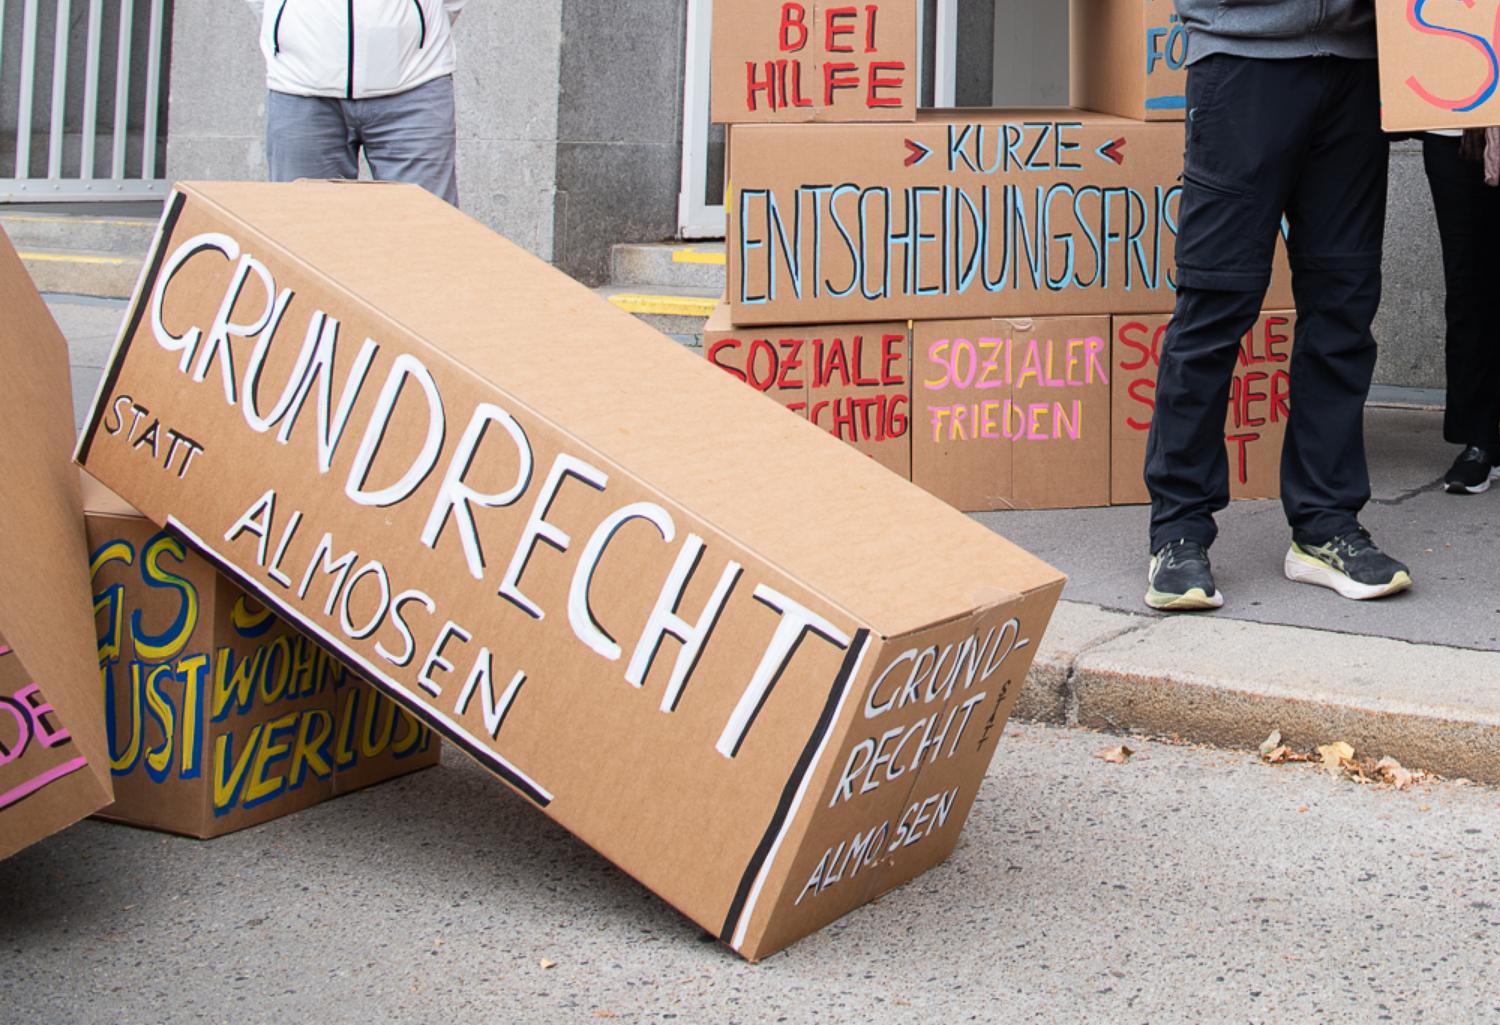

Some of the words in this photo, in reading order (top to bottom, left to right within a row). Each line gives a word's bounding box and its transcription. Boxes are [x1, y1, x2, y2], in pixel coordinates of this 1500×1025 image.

[779, 2, 878, 53] BEI
[746, 61, 905, 112] HILFE
[946, 122, 1084, 174] KURZE
[739, 183, 1184, 305] ENTSCHEIDUNGSFRIS
[924, 336, 1109, 391] SOZIALER
[103, 394, 204, 479] STATT
[929, 399, 1083, 444] FRIEDEN
[150, 232, 853, 758] GRUNDRECHT
[224, 489, 526, 740] ALMOSEN
[864, 616, 1030, 719] GRUND-
[828, 692, 986, 808] RECHT
[794, 786, 959, 906] ALMOSEN
